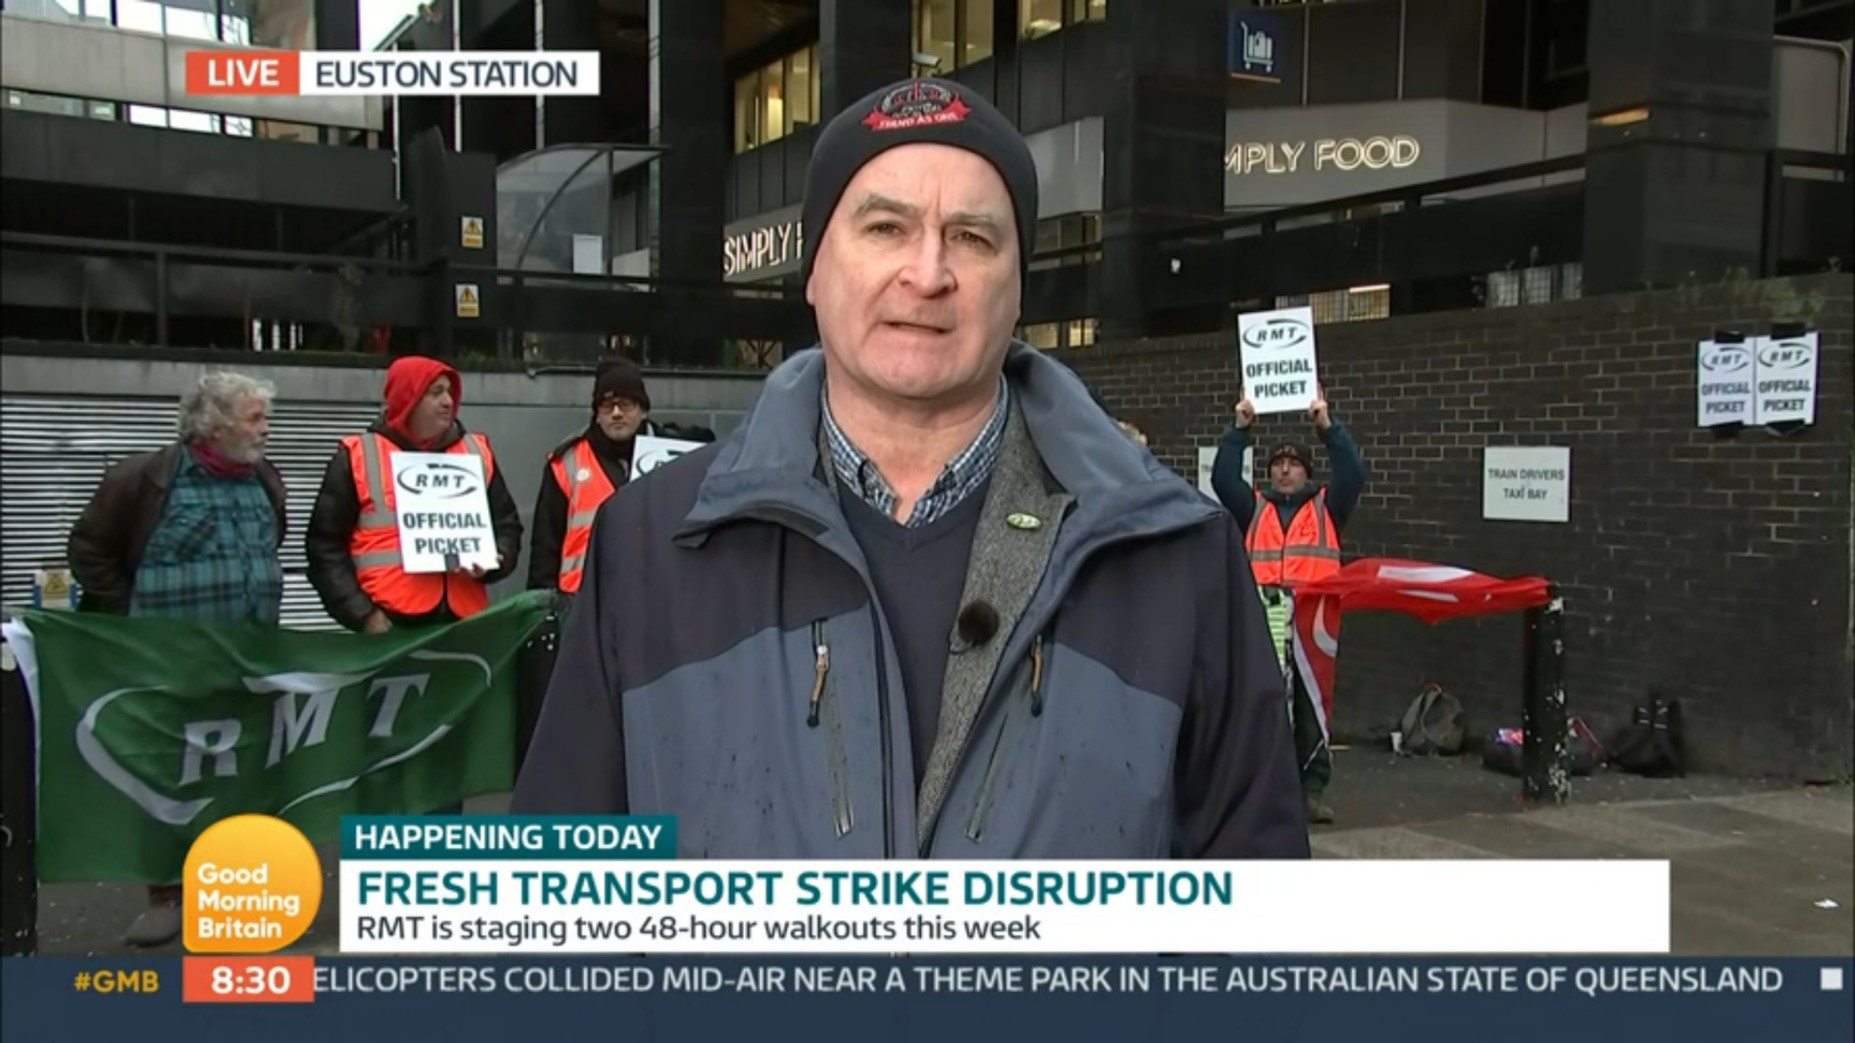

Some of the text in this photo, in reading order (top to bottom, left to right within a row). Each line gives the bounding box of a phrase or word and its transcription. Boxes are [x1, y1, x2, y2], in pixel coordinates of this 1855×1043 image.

[1314, 135, 1420, 171] FOOD
[724, 222, 791, 276] SIMPLY
[1257, 327, 1297, 341] RMT
[1711, 354, 1741, 365] RMT
[1770, 350, 1803, 361] RMT
[1246, 359, 1312, 378] OFFICIAL
[1254, 381, 1306, 398] PICKET
[1702, 382, 1750, 396] OFFICIAL
[1759, 380, 1811, 393] OFFICIAL
[1706, 401, 1745, 414] PICKET
[1764, 399, 1805, 412] PICKET
[416, 474, 465, 488] RMT
[1488, 469, 1565, 481] TRAIN DRIVERS
[1503, 487, 1547, 499] TAXI BAY
[403, 512, 487, 529] OFFICIAL
[414, 537, 481, 554] PICKET
[179, 674, 431, 784] RMT
